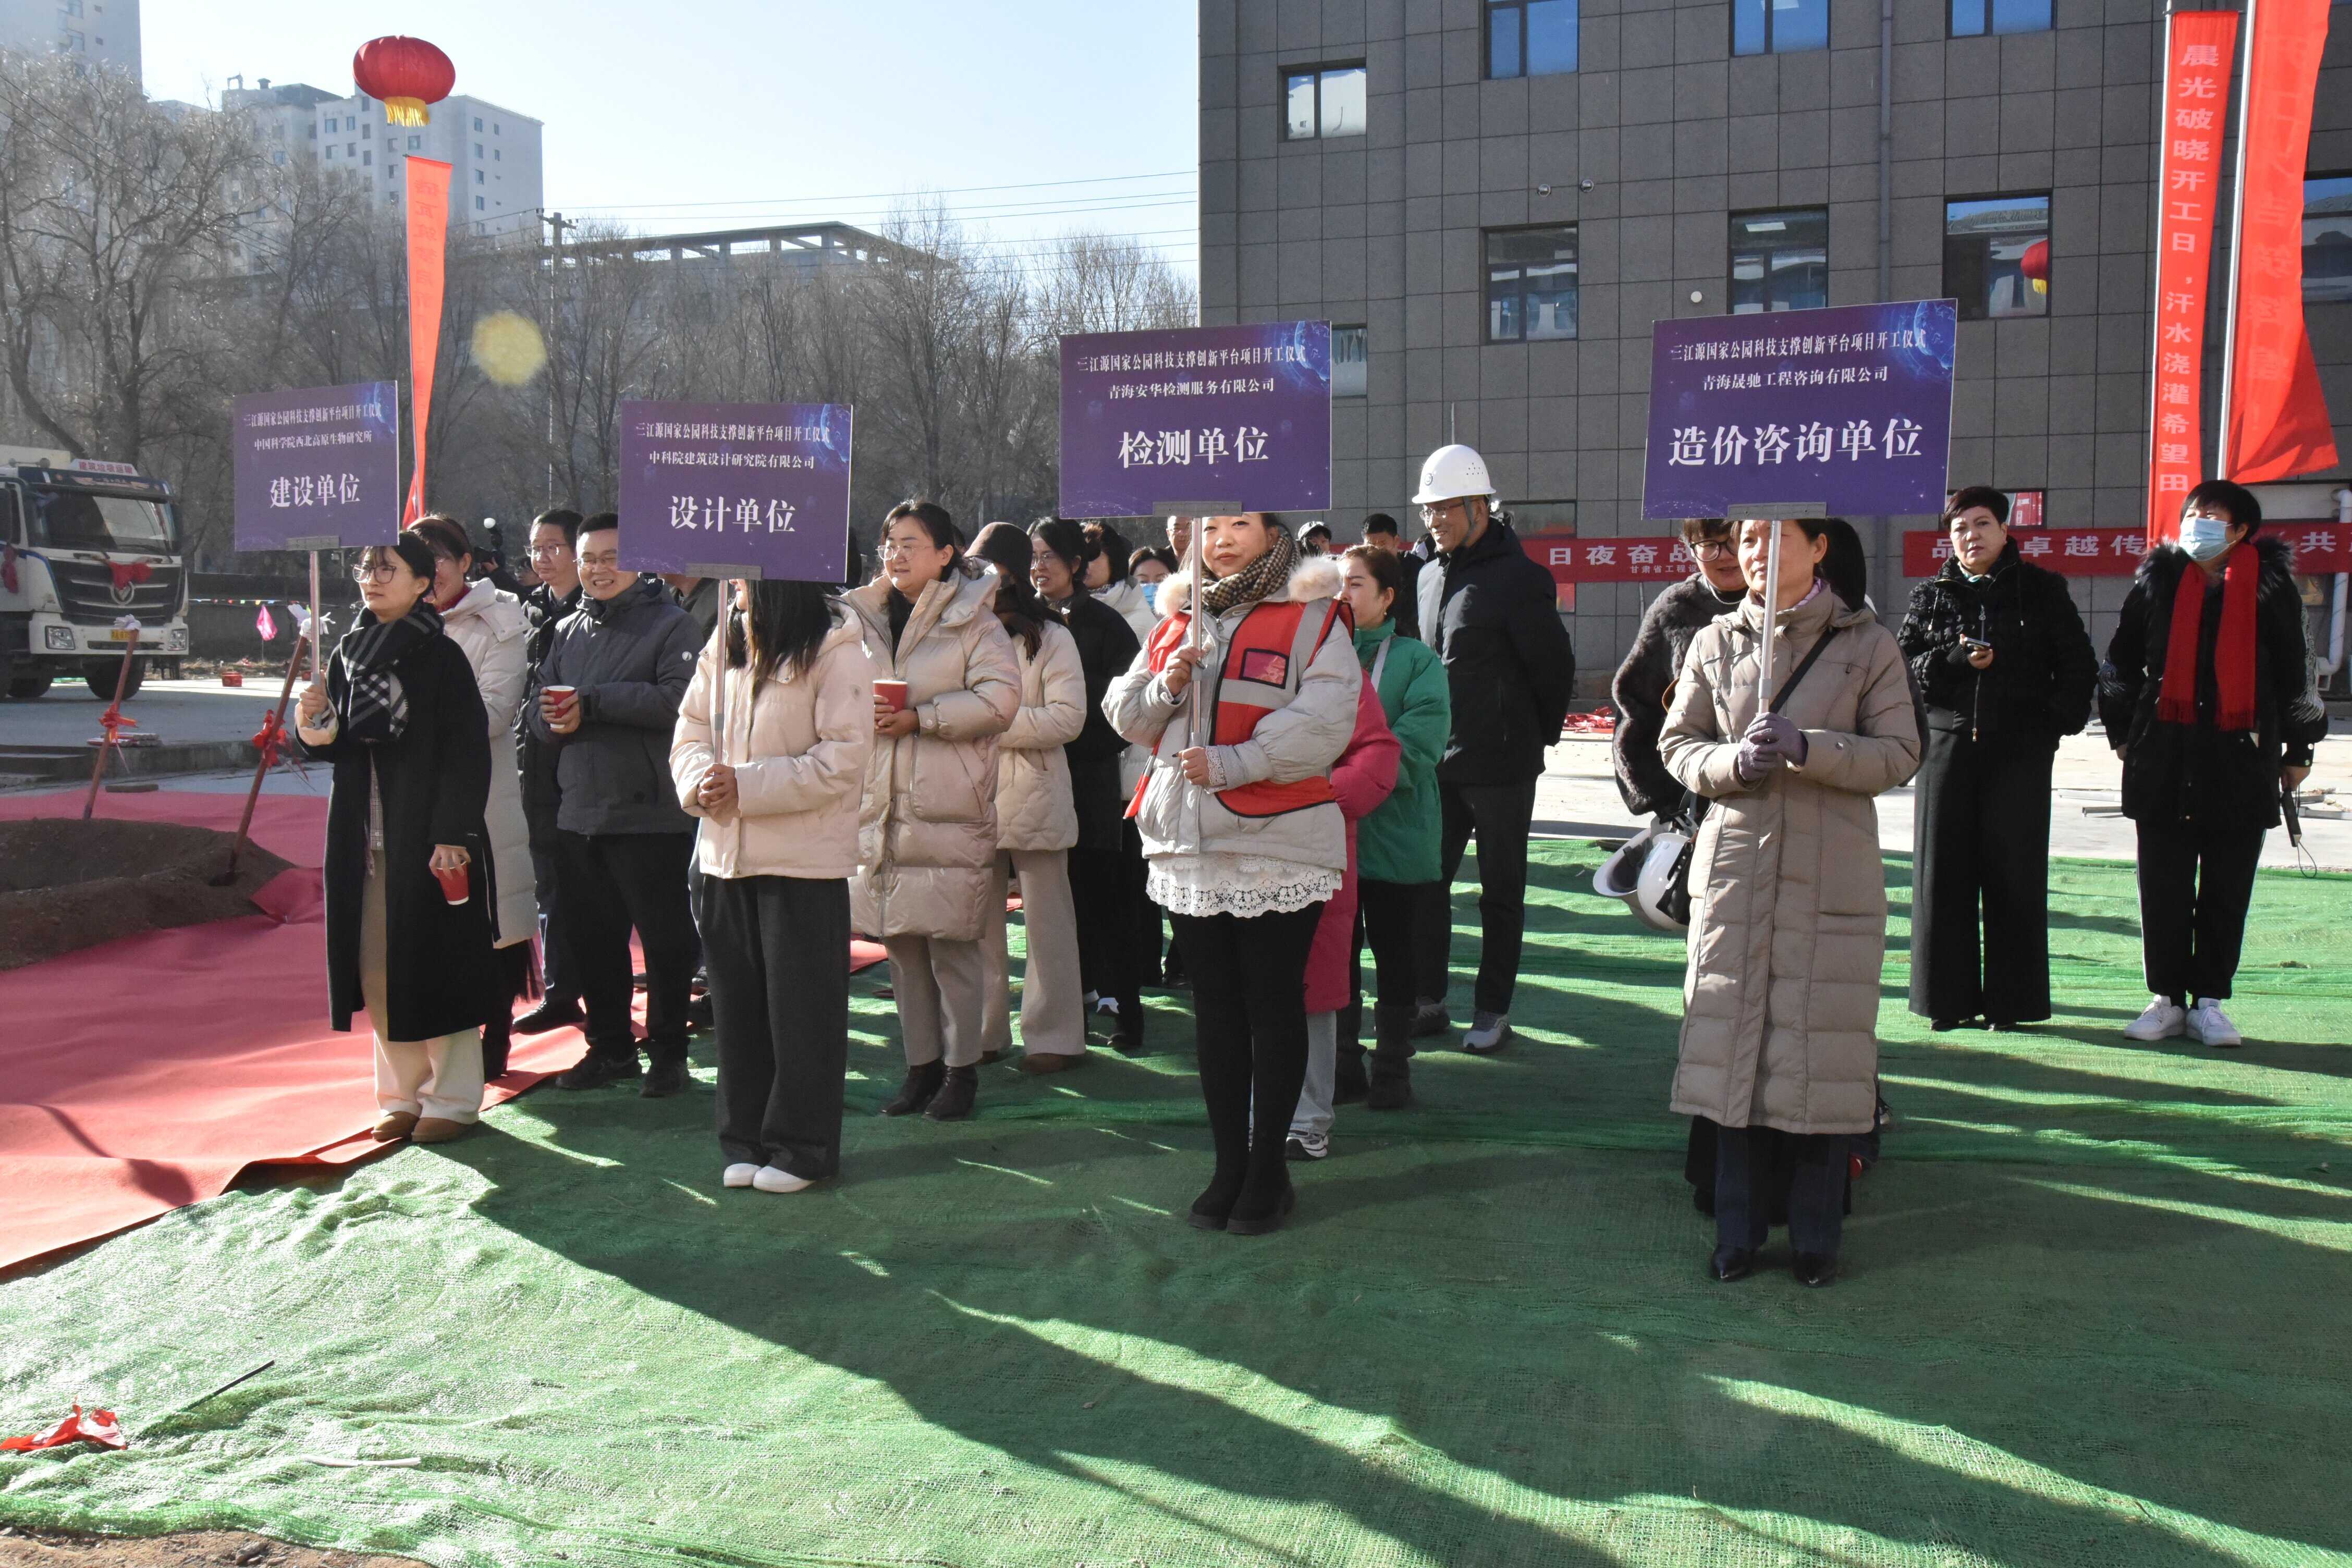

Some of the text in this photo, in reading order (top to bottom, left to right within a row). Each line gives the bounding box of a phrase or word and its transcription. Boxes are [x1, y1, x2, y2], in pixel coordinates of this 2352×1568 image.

[1670, 329, 1926, 361] 三江源国家公园科技支撑创新平台项目开工仪式
[1078, 345, 1307, 372] 三江源国家公园科技支撑创新平台项目开工仪式
[1108, 377, 1275, 399] 青海安华检测服务有限公司
[1702, 365, 1888, 391] 青海晟驰工程咨询有限公司
[244, 403, 382, 427] 三江源国家公园科技支撑创新平台项目开工仪式
[254, 431, 372, 451] 中国科学院西北高原生物研究所
[636, 422, 830, 443] 三江源国家公园科技支撑创新平台项目开工仪式
[1668, 418, 1923, 466] 造价咨询单位
[649, 451, 815, 469] 中科院建筑设计研究院有限公司
[1118, 426, 1269, 469] 检测单位
[270, 473, 361, 509] 建设单位
[668, 496, 796, 533] 设计单位
[1549, 544, 1697, 566] 日夜奋战
